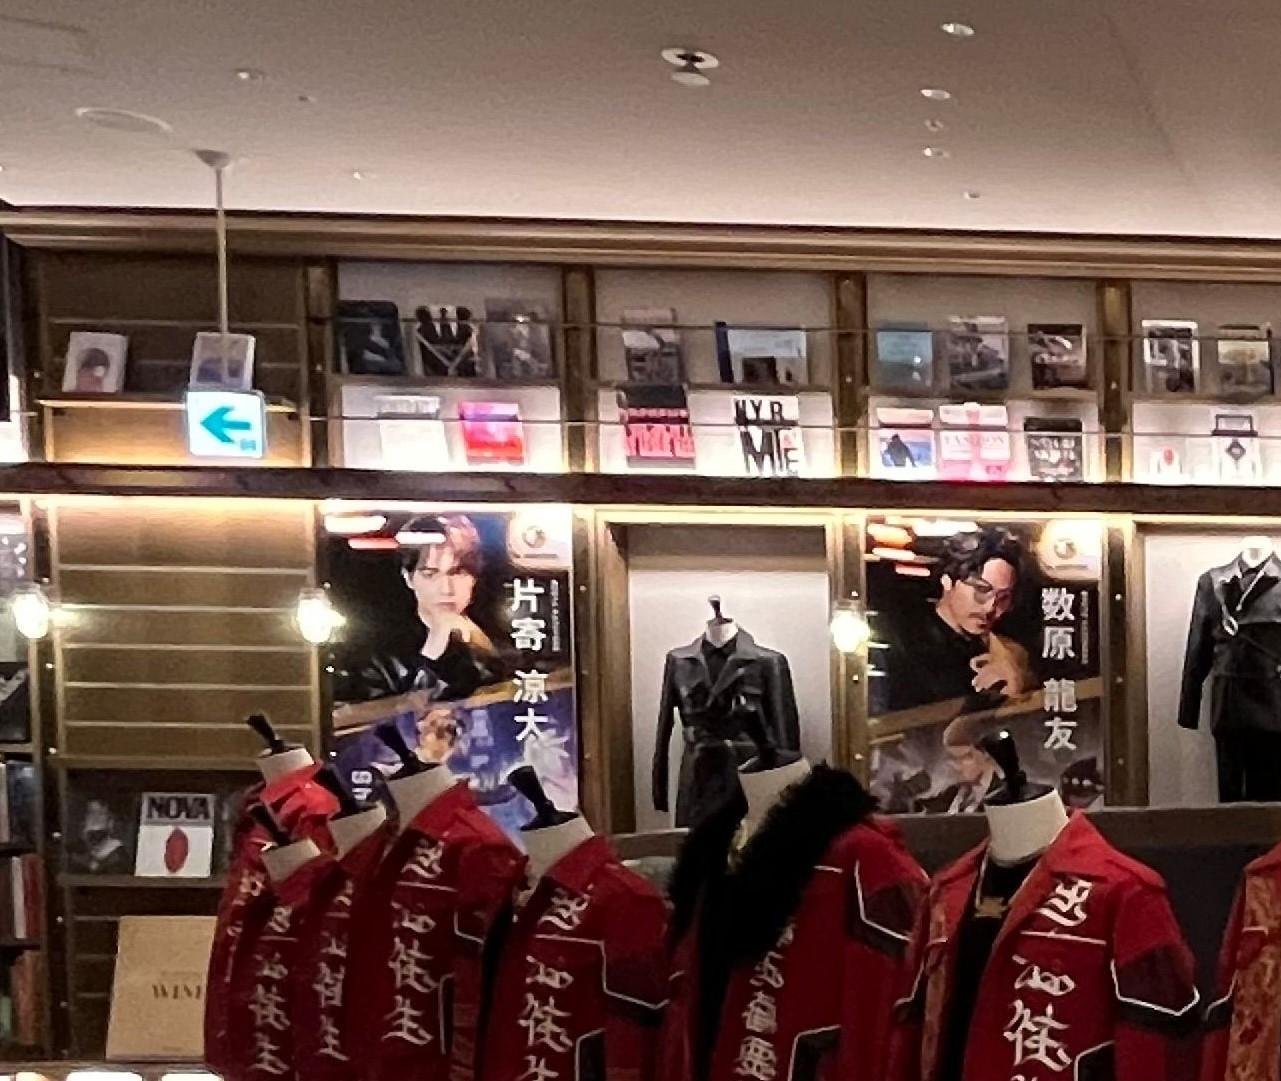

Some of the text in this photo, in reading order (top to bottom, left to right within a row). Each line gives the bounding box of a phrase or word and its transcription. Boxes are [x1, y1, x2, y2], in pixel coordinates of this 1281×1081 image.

[511, 577, 547, 651] 片寄
[1041, 588, 1078, 750] 数原 龍友
[146, 796, 211, 820] NOVA
